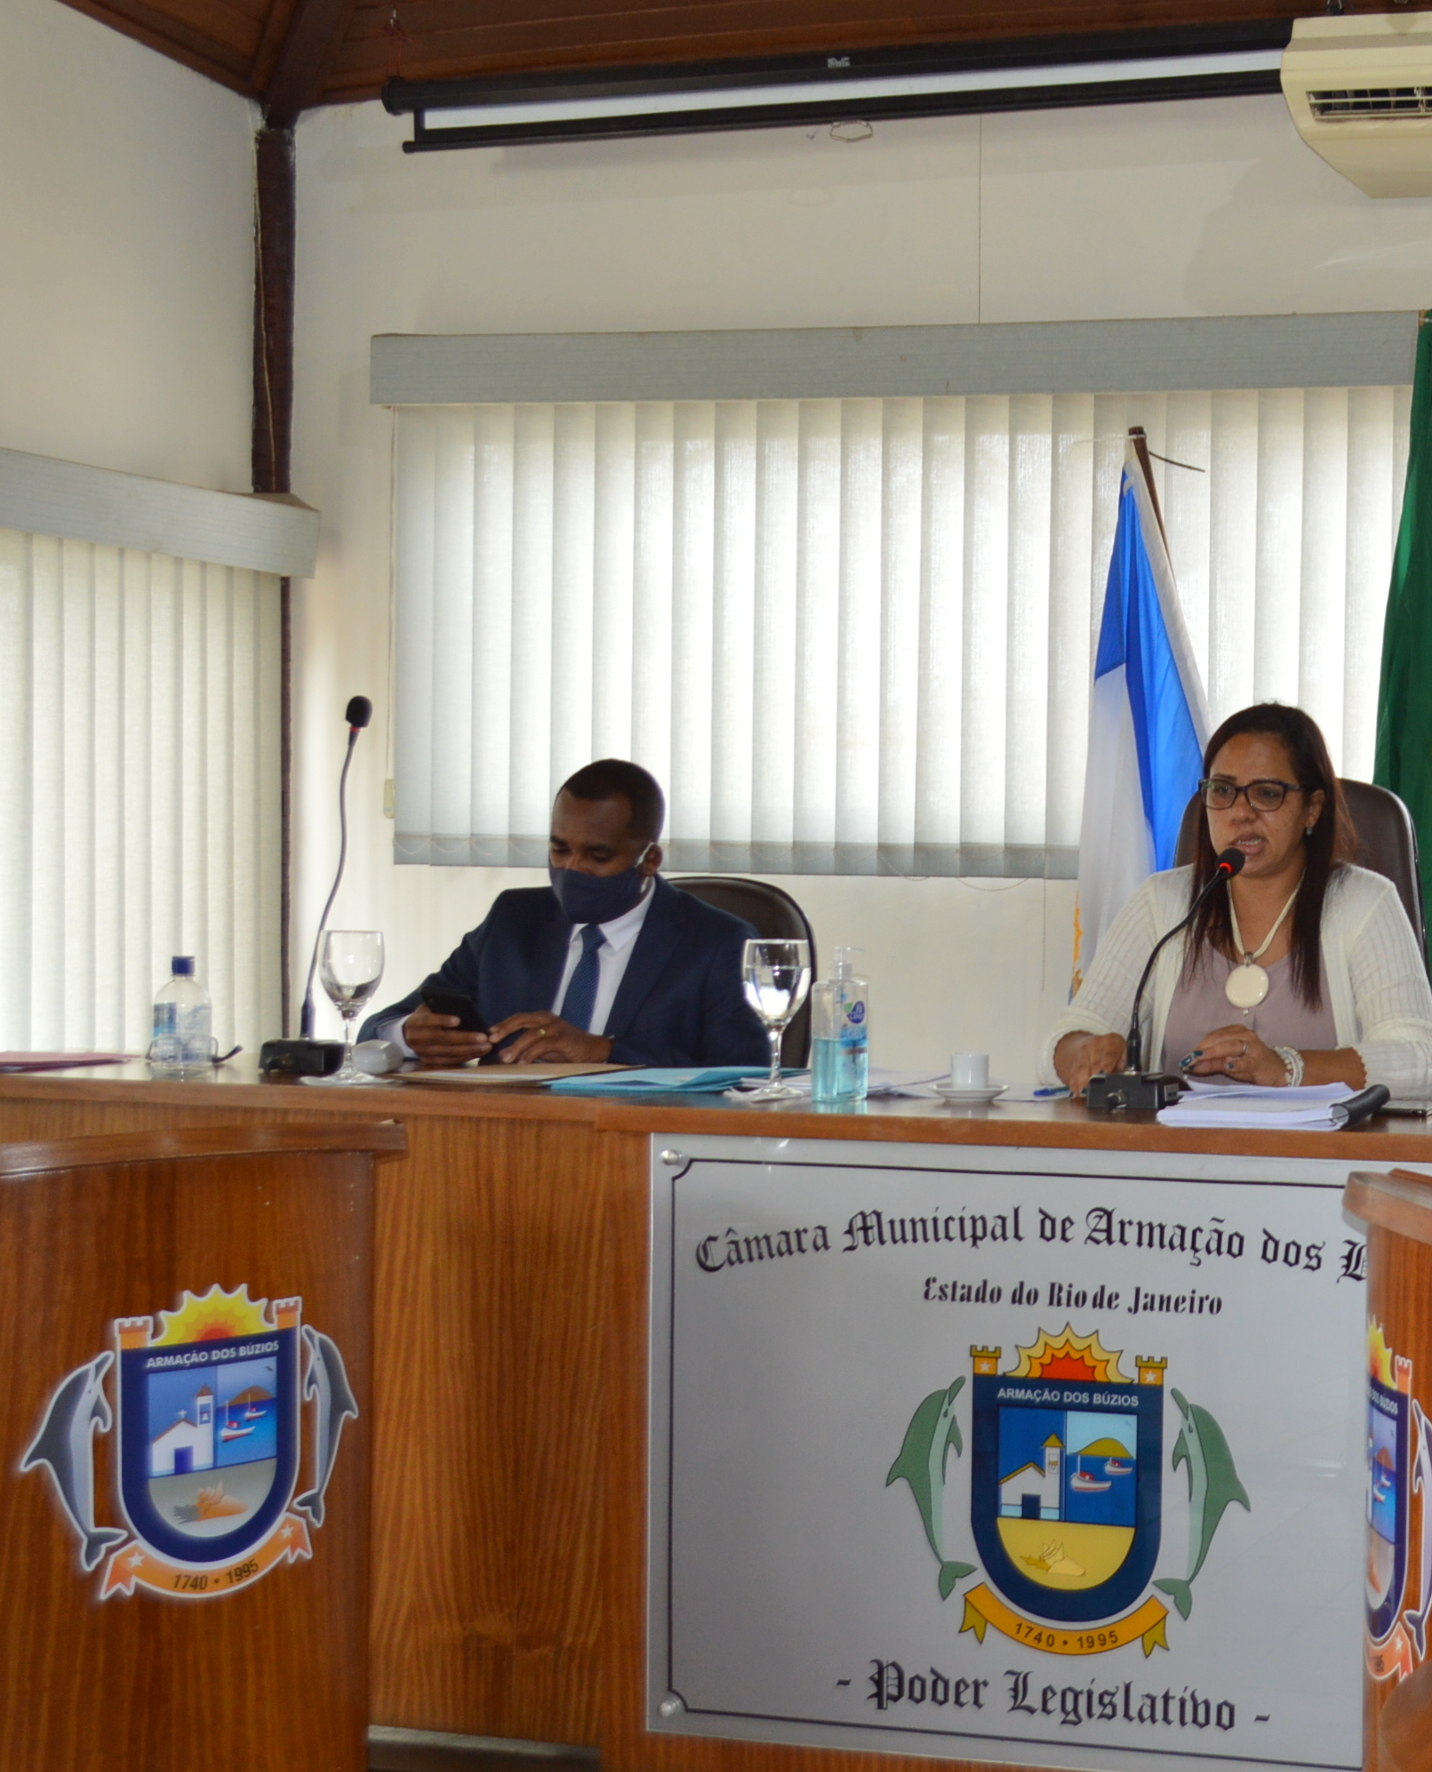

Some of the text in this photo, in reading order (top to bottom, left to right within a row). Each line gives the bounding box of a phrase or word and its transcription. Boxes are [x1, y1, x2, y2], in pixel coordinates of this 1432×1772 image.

[695, 1224, 831, 1272] Câmara
[842, 1205, 1025, 1253] Municipal
[1038, 1207, 1075, 1243] de
[1084, 1206, 1245, 1267] Armação
[1260, 1228, 1325, 1272] dos
[923, 1276, 1223, 1314] Estado do Rio de Janeiro
[146, 1340, 280, 1368] ARMAÇÃO DOS BÚZIOS
[997, 1387, 1139, 1407] ARMAÇÃO DOS BÚZIOS
[173, 1558, 259, 1590] 1740 1995
[1015, 1622, 1119, 1649] 1740 1995
[867, 1658, 990, 1711] Poder
[1003, 1669, 1236, 1732] Legislativo
